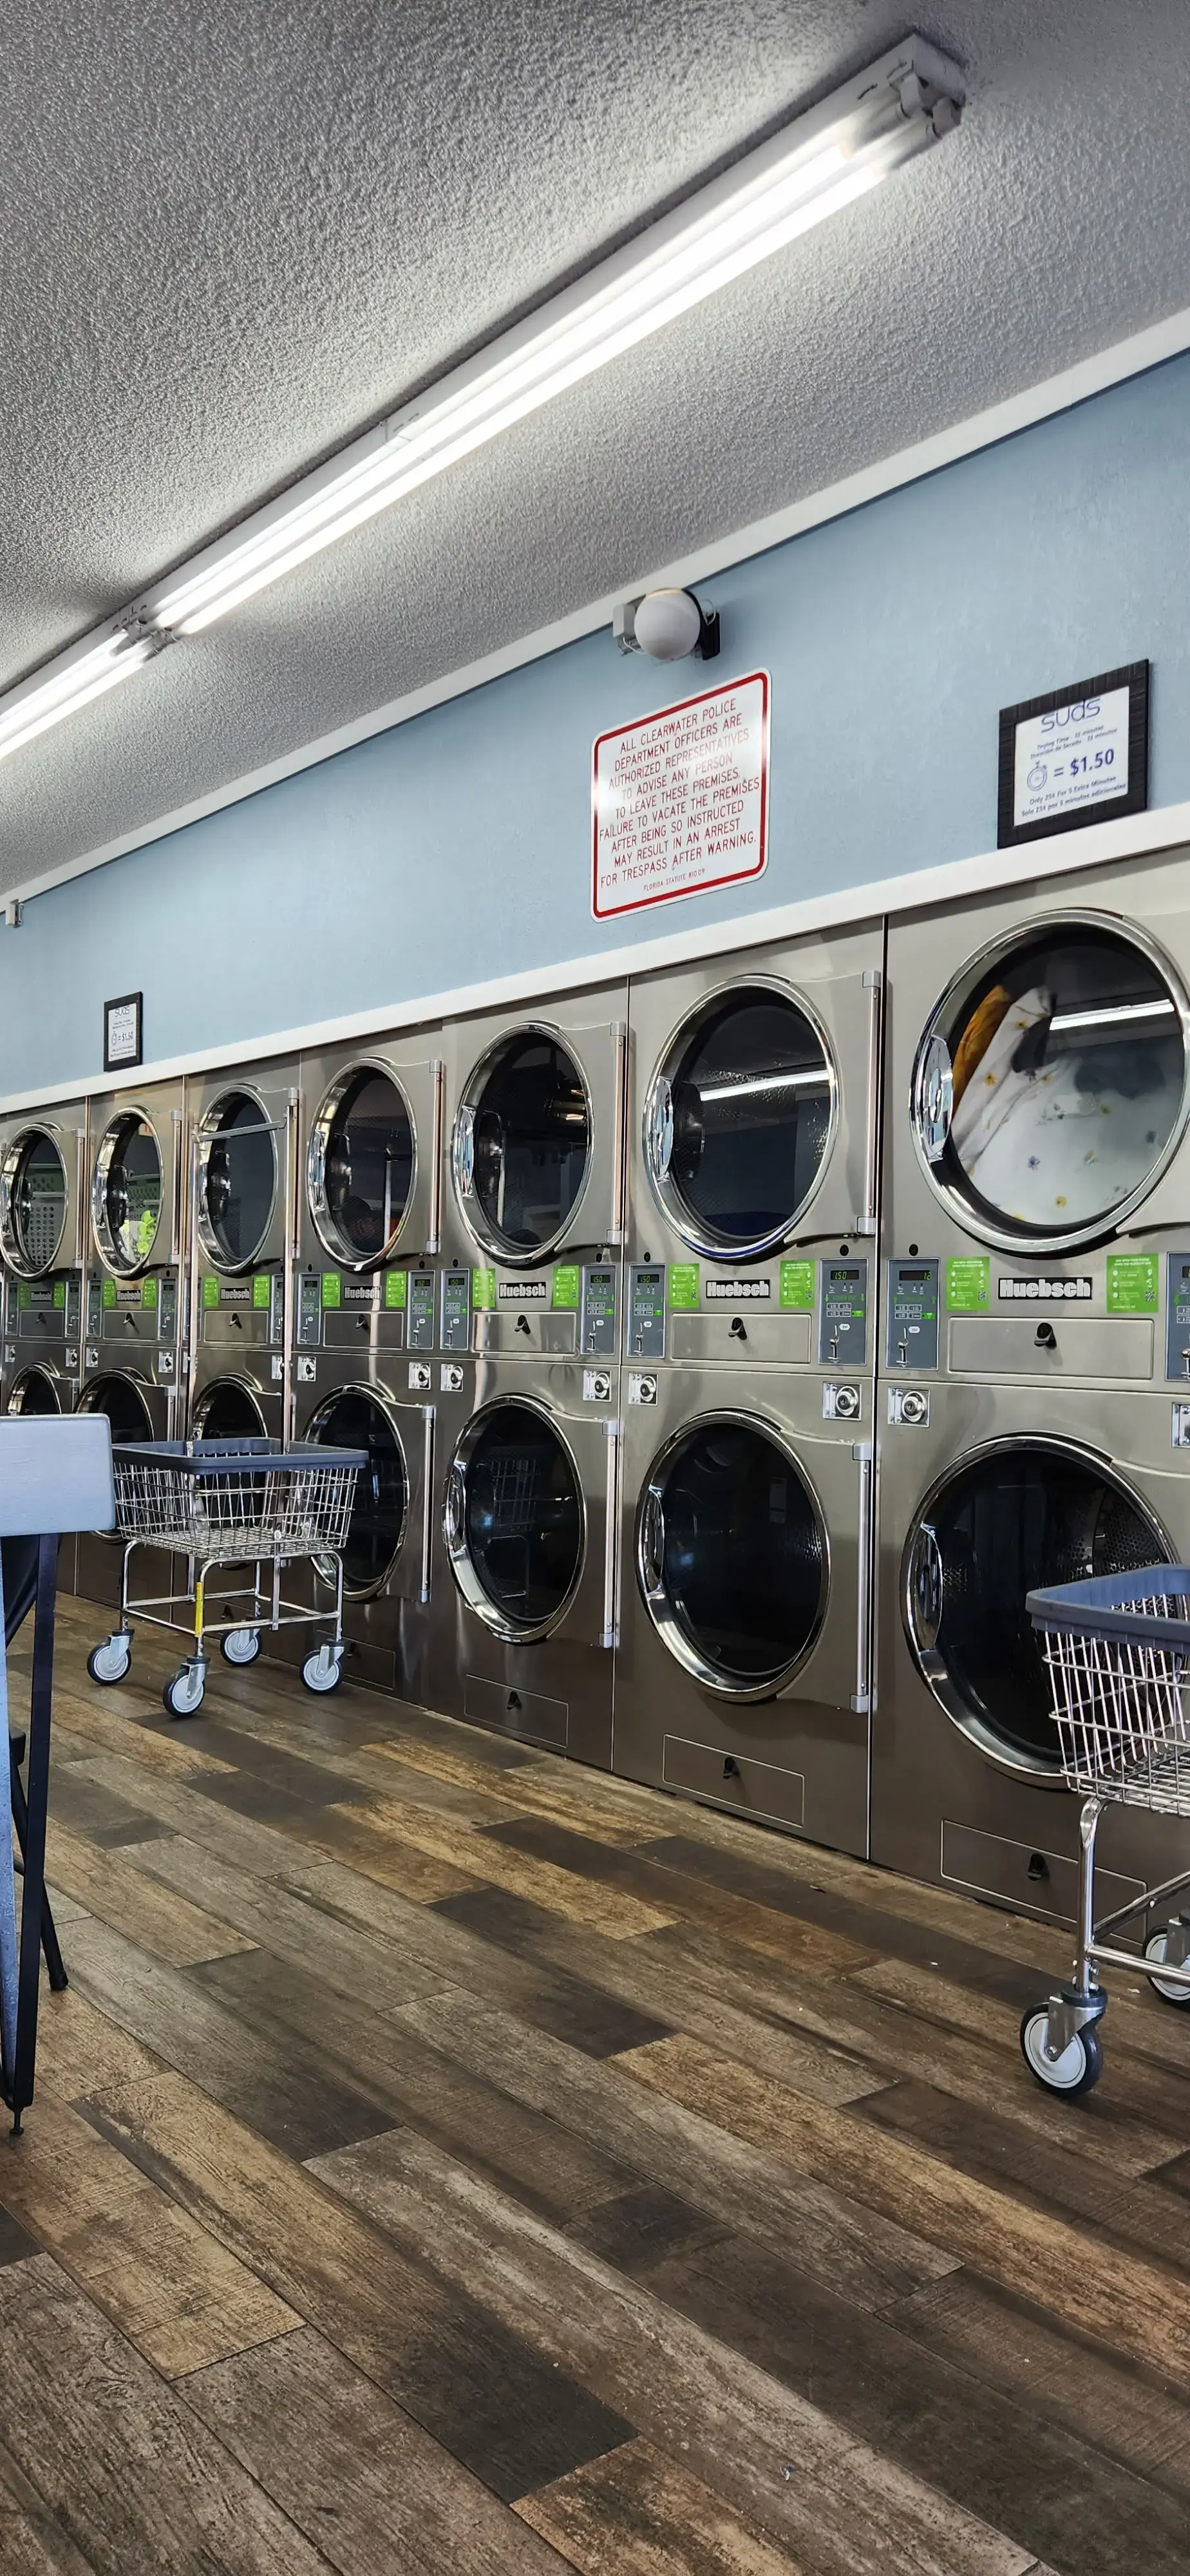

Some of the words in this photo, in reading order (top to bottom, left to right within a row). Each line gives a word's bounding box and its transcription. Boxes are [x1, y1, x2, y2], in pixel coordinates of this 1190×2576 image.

[615, 741, 670, 772] DEPARTMENT
[674, 723, 718, 749] OFFICERS
[722, 713, 742, 731] ARE
[620, 742, 636, 754] ALL
[641, 714, 697, 746] CLEARWATER
[703, 698, 736, 722] POLICE
[609, 761, 661, 790] AUTHORIZED
[665, 728, 749, 769] REPRESENTATIVES
[621, 788, 632, 802] TO
[637, 775, 667, 796] ADVISE
[671, 766, 690, 783] ANY
[695, 752, 733, 776] PERSON
[1070, 748, 1114, 778] $1.50
[600, 819, 634, 841] FAILURE
[638, 815, 648, 828] TO
[652, 801, 686, 823] VACATE
[691, 794, 708, 810] THE
[713, 777, 760, 803] PREMISES
[616, 806, 625, 820] TO
[630, 795, 657, 815] LEAVE
[661, 784, 688, 804] THESE
[611, 835, 637, 854] AFTER
[641, 824, 666, 844] BEING
[671, 820, 683, 833] SO
[687, 800, 744, 828] INSTRUCTED
[614, 852, 633, 868] MAY
[637, 839, 669, 862] RESULT
[673, 837, 681, 849] IN
[686, 831, 699, 846] AN
[704, 818, 741, 840] ARREST
[601, 873, 618, 888] FOR
[622, 857, 667, 882] TRESPASS
[672, 847, 702, 867] AFTER
[708, 831, 757, 856] WARNING.
[643, 880, 664, 891] FLORIDA
[666, 873, 686, 886] STATUTE
[122, 1031, 134, 1041] $1.50
[345, 1287, 381, 1299] Huebsch
[499, 1283, 545, 1298] Huebsch
[707, 1281, 770, 1298] Huebsch
[999, 1279, 1091, 1298] Huebsch
